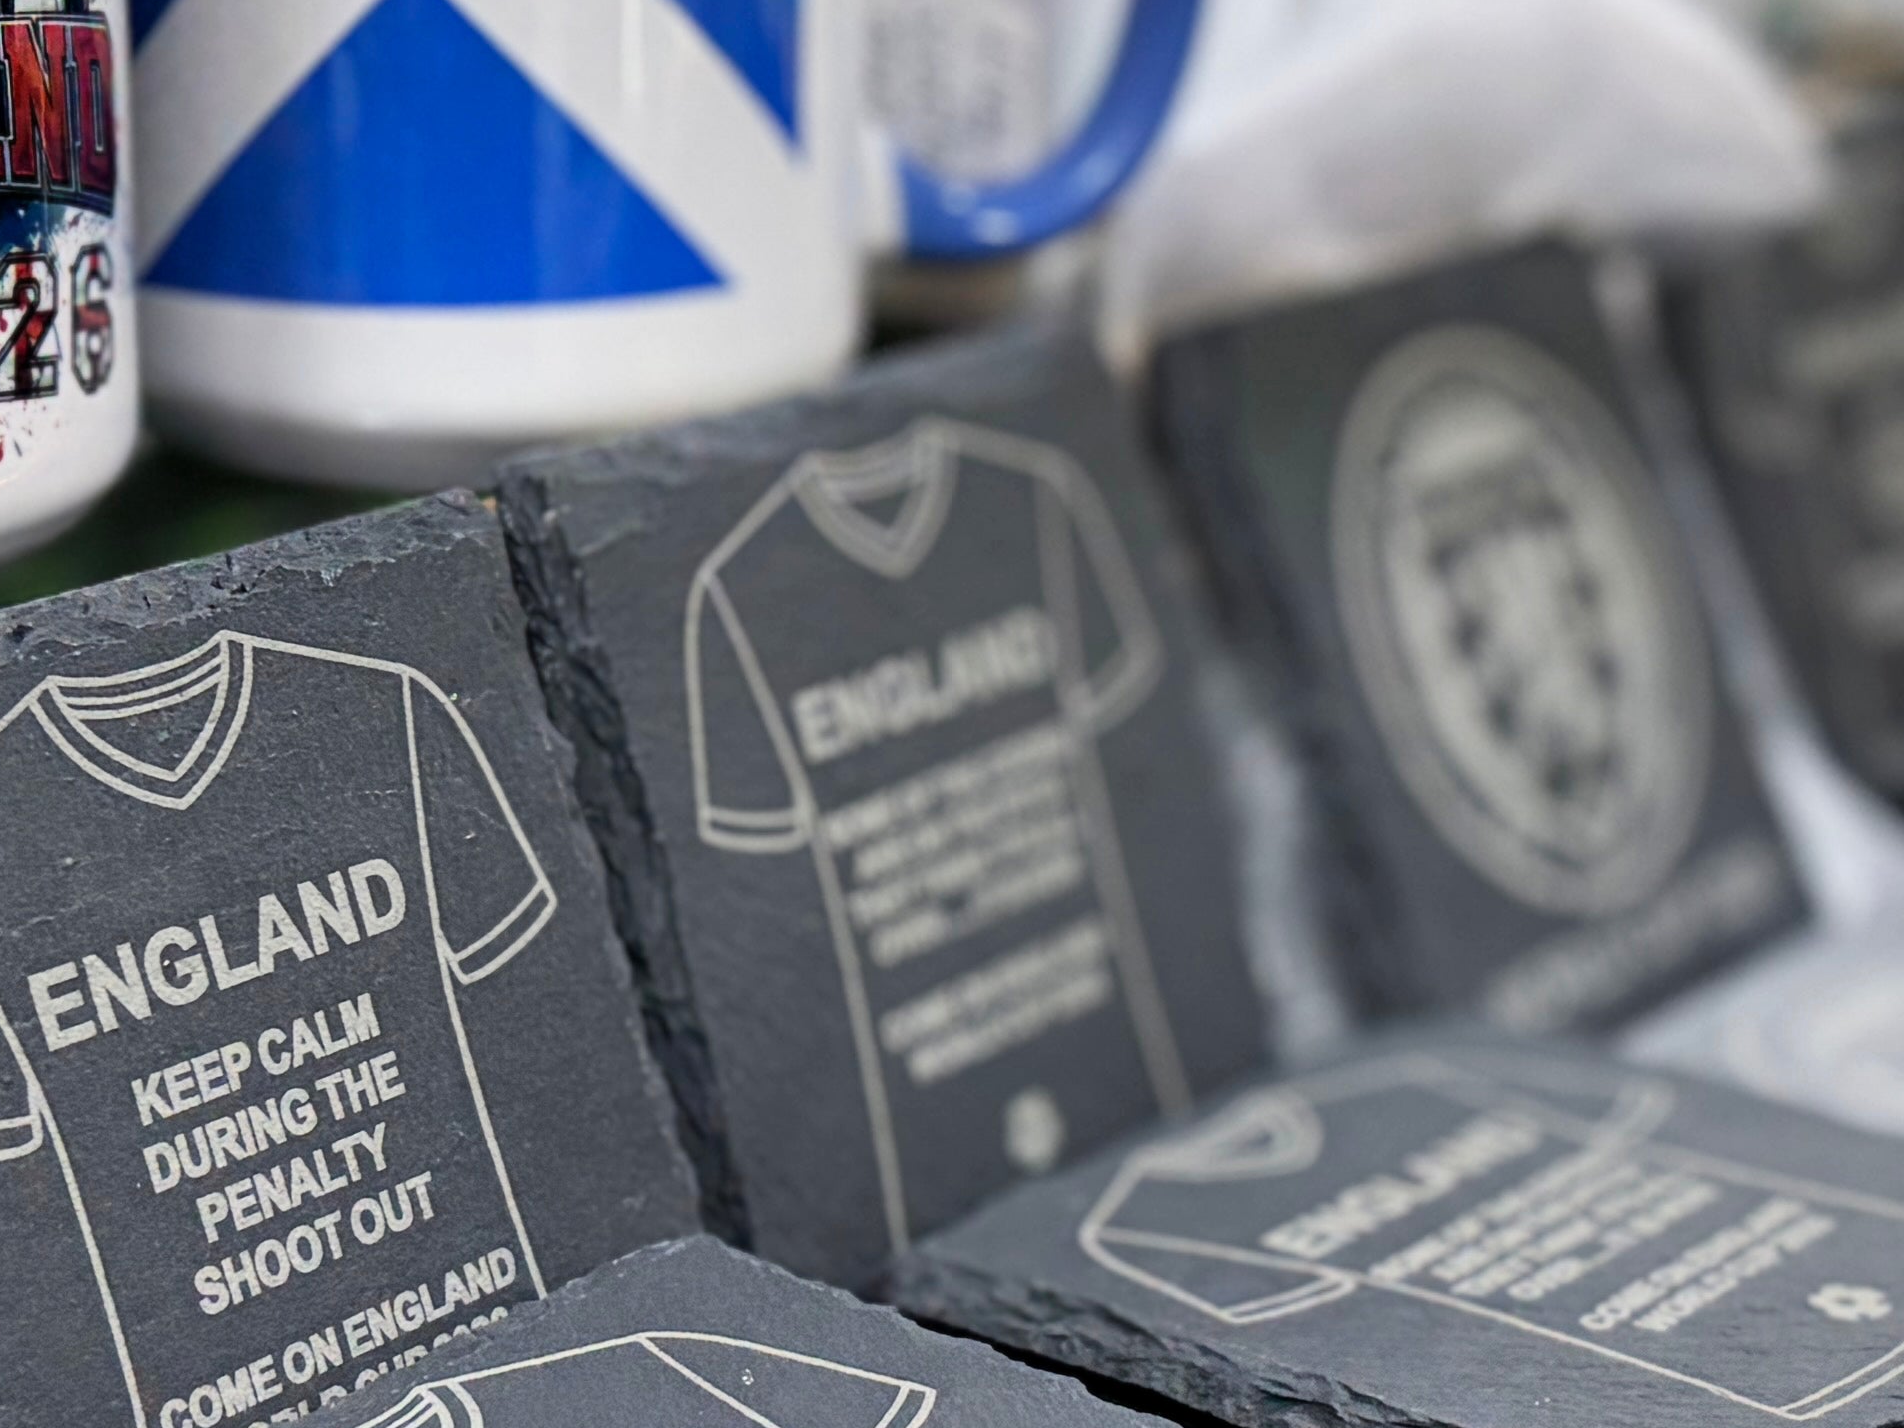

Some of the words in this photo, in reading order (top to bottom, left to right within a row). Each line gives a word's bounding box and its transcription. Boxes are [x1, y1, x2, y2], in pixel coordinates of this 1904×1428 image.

[27, 858, 407, 1051] ENGLAND
[131, 1041, 253, 1125] KEEP
[258, 993, 381, 1075] CALM
[143, 1086, 318, 1193] DURING
[316, 1051, 406, 1117] THE
[194, 1210, 344, 1315] SHOOT
[350, 1172, 434, 1244] OUT
[197, 1122, 388, 1243] PENALTY
[282, 1326, 344, 1384] ON
[342, 1247, 517, 1358] ENGLAND
